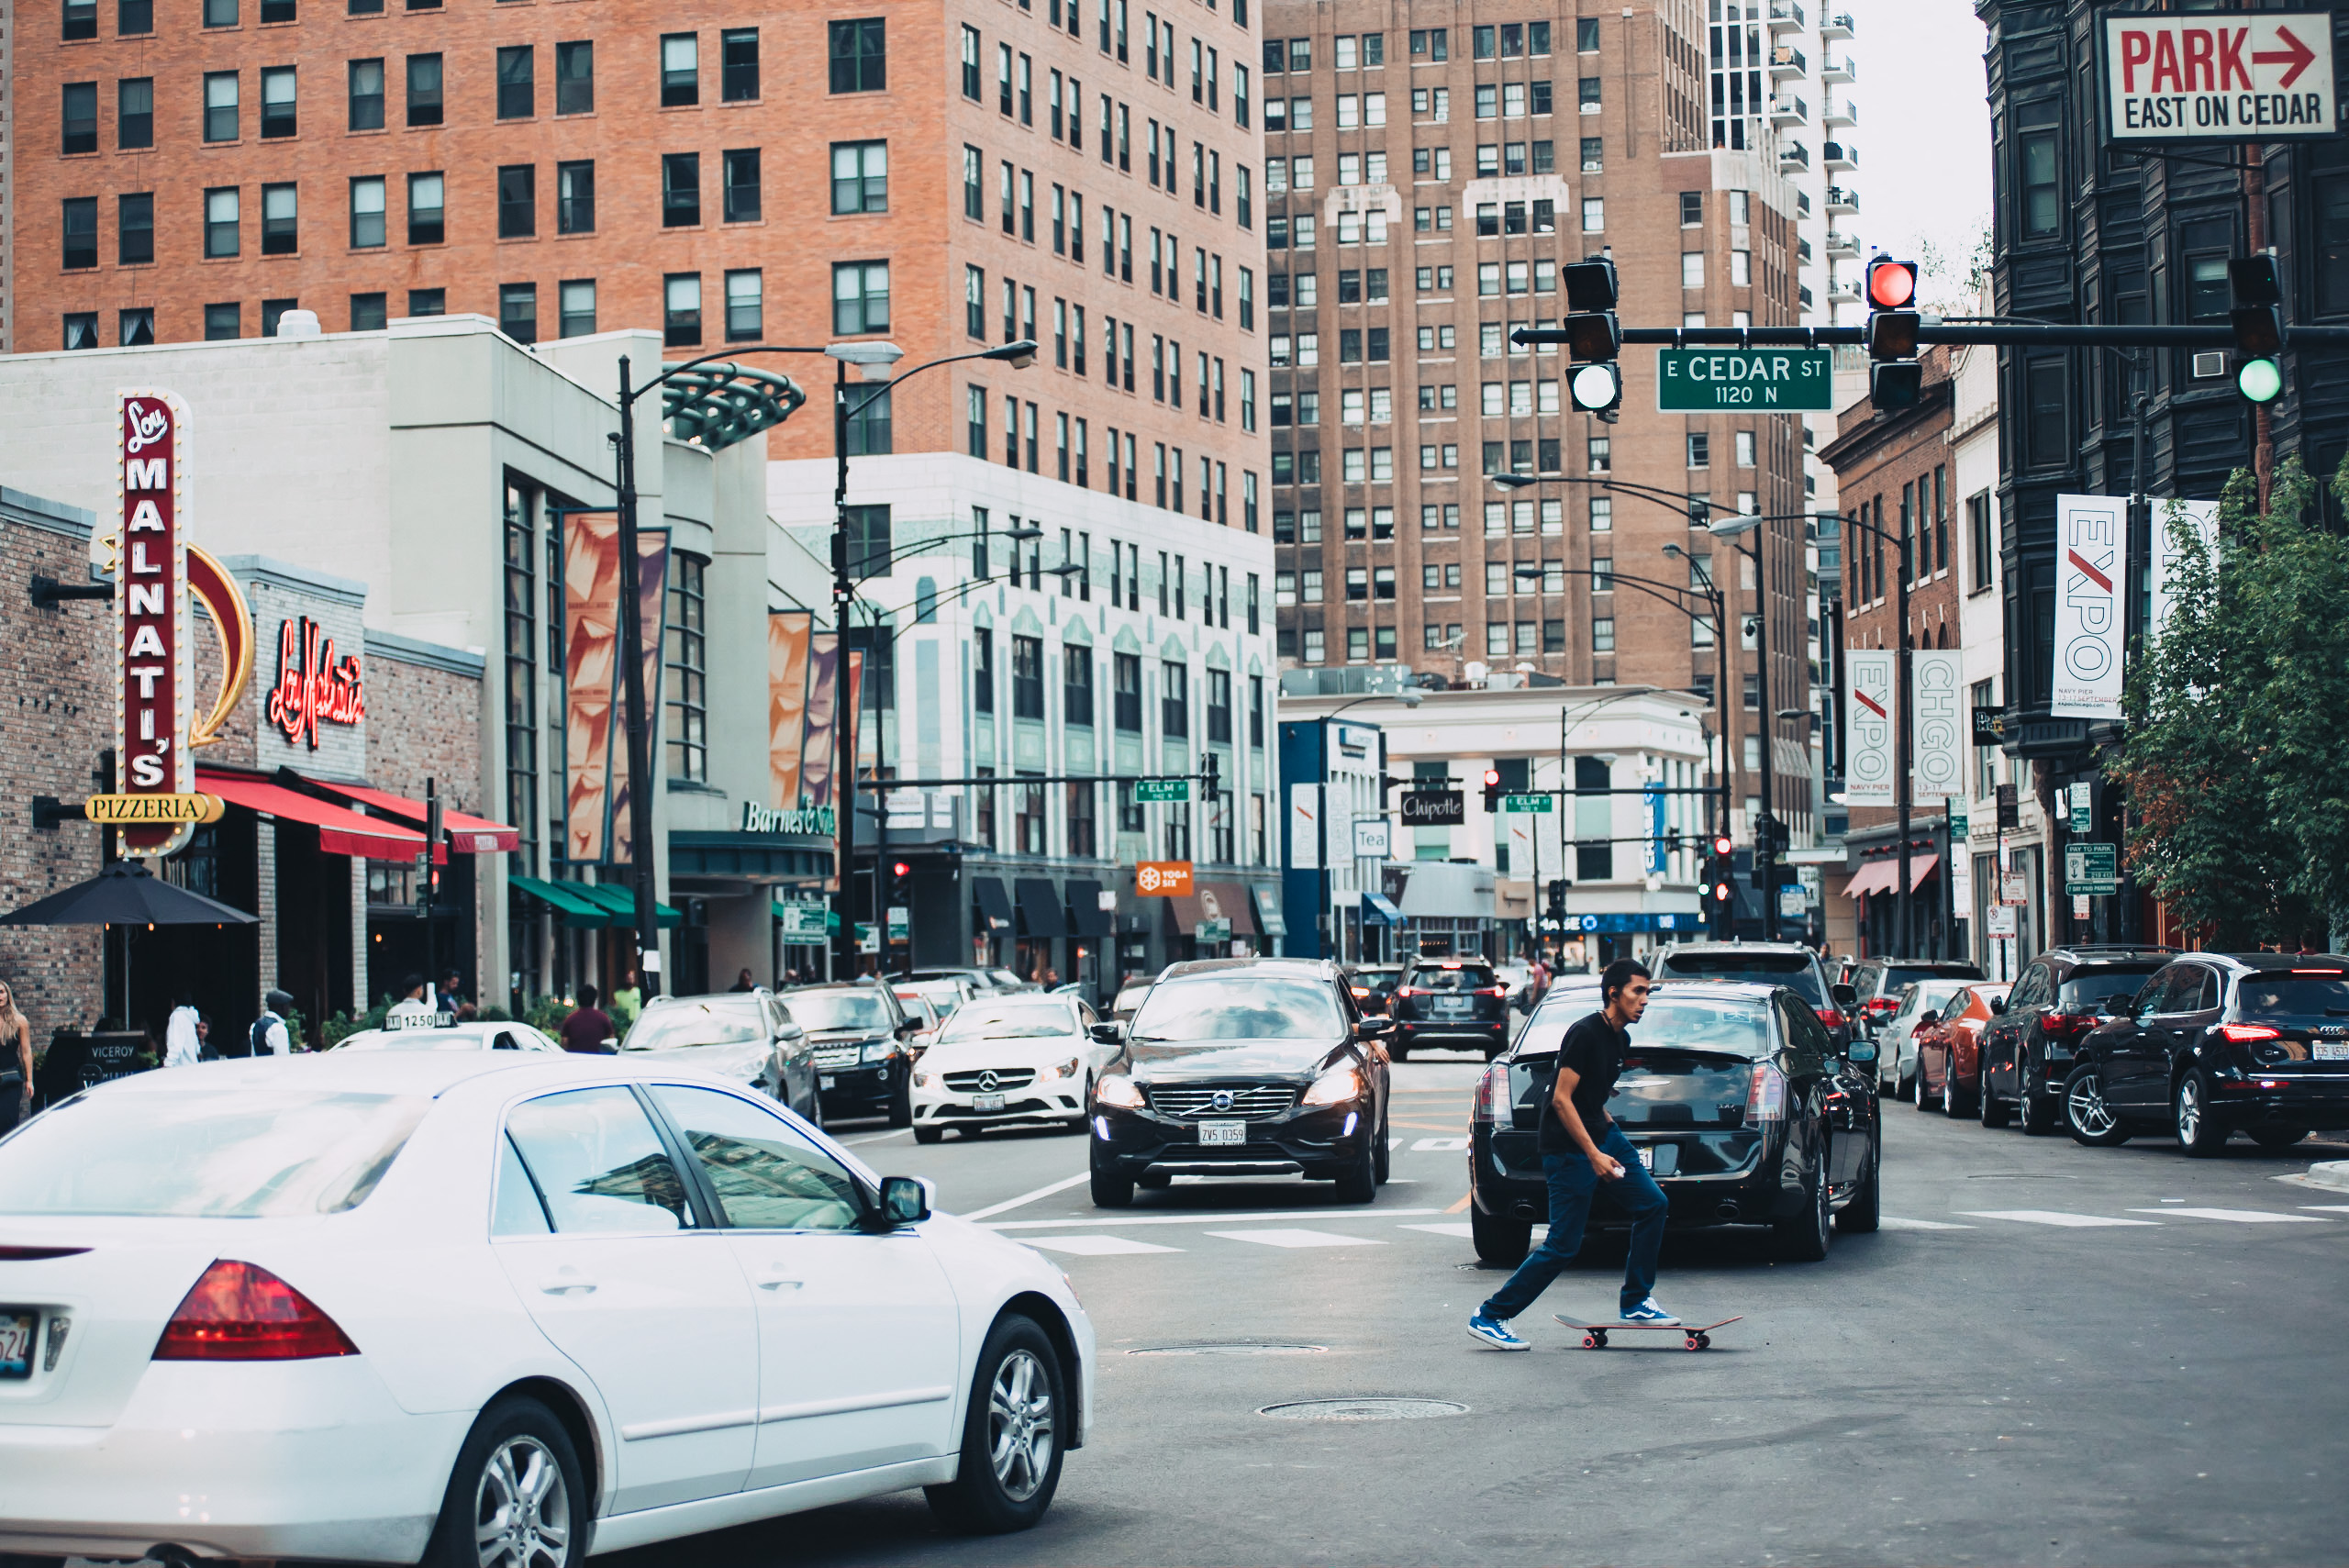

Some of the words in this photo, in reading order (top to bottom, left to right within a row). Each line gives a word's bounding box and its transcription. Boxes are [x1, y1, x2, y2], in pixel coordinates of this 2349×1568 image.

[2121, 28, 2254, 94] PARK
[2125, 96, 2187, 128] EAST
[2196, 95, 2230, 127] ON
[2238, 94, 2321, 126] CEDAR
[1667, 361, 1678, 377] E
[1688, 356, 1790, 381] CEDAR
[1800, 361, 1823, 377] ST
[1716, 386, 1753, 403] 1120
[1765, 387, 1777, 403] N
[127, 400, 168, 454] Lou
[2065, 509, 2114, 681] EXPO
[126, 458, 170, 787] MALNATI'S
[1854, 661, 1887, 782] EXPO
[1920, 659, 1955, 784] CHGO
[1148, 784, 1174, 793] ELM
[92, 798, 199, 819] PIZZERIA
[1402, 796, 1463, 821] Chipotle
[1517, 797, 1540, 806] ELM
[745, 801, 804, 834] Barnes
[1359, 831, 1385, 846] Tea
[405, 1015, 433, 1027] 1250
[92, 1046, 134, 1057] VICEROY
[1222, 1129, 1244, 1141] 0359
